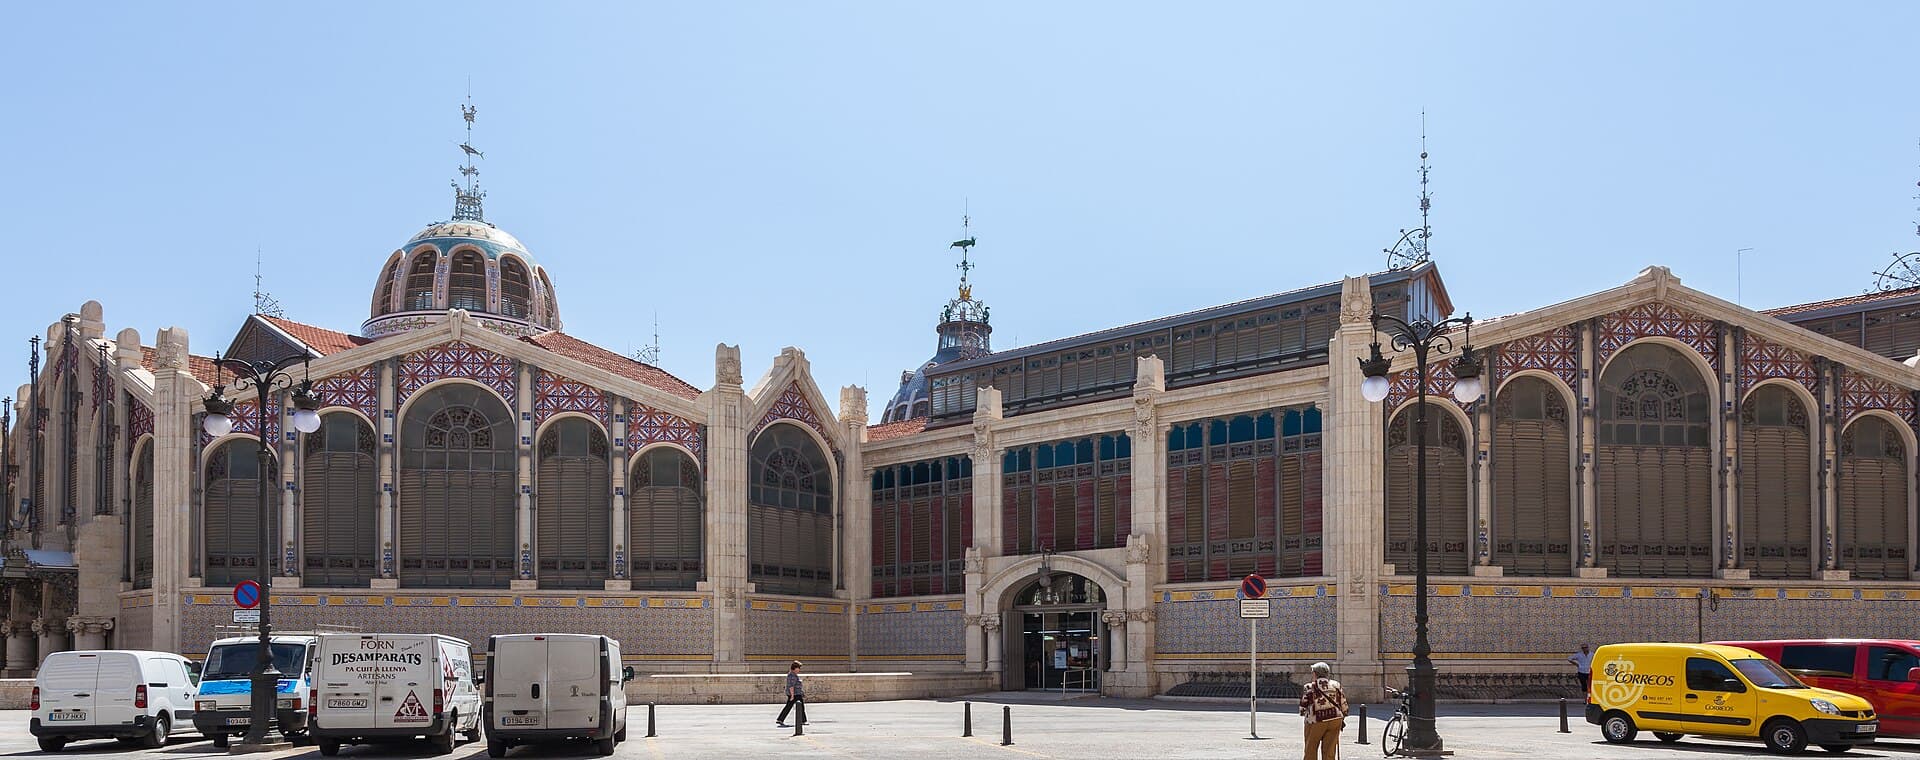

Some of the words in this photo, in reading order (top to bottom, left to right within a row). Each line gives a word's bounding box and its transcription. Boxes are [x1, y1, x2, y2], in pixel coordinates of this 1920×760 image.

[360, 640, 395, 650] FORN
[332, 652, 422, 666] DESAMPARATS
[1615, 670, 1676, 687] CORREOS
[1704, 703, 1735, 712] CORREOS
